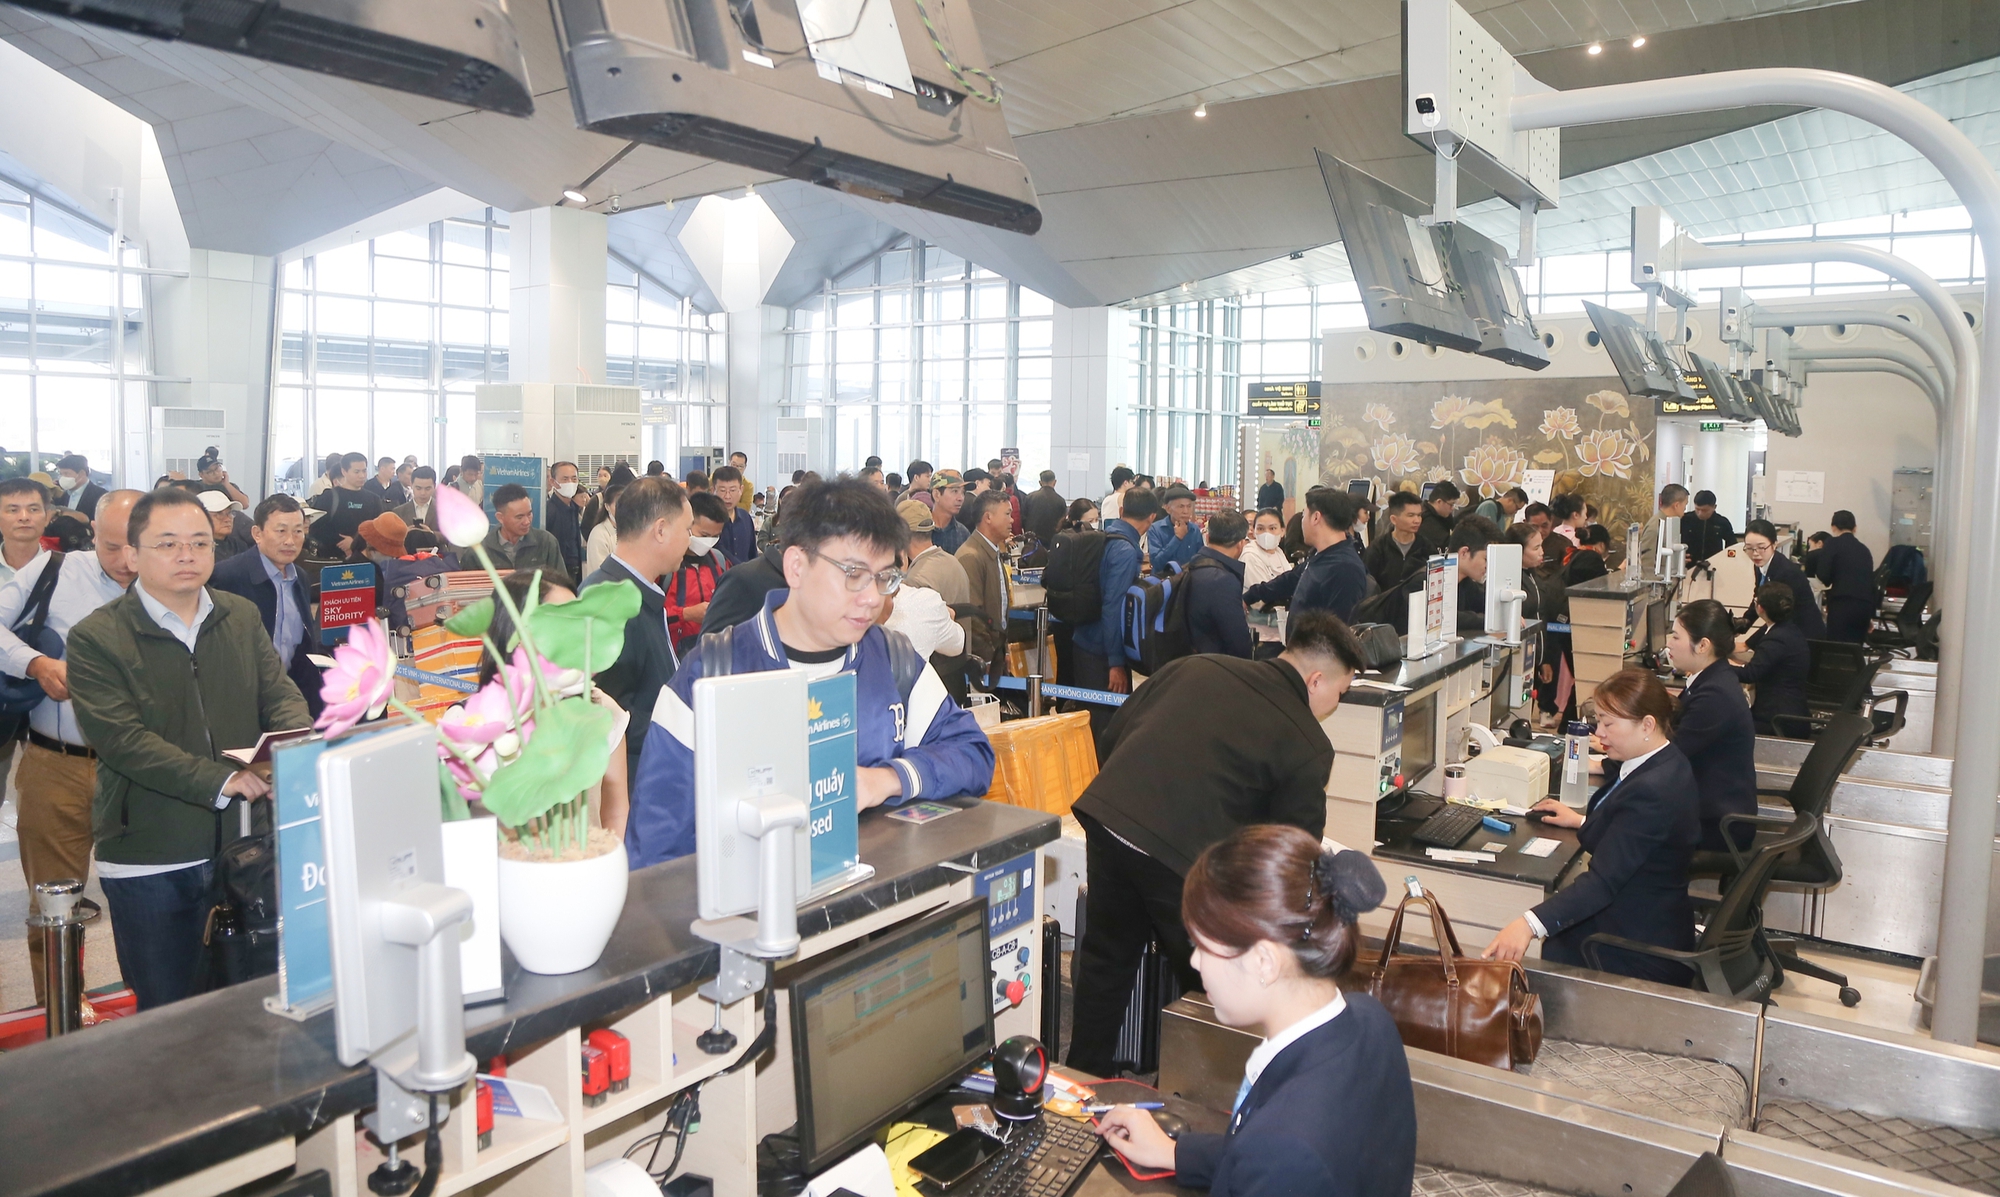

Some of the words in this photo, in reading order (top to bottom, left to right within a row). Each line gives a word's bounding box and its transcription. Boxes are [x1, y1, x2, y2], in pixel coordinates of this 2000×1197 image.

[323, 598, 342, 606] KHÁCH
[324, 606, 342, 615] SKY
[324, 611, 364, 622] PRIORITY
[407, 669, 418, 678] VINH
[419, 672, 430, 681] VINH
[429, 675, 462, 689] INTERNATIONAL
[461, 682, 479, 692] AIRPOR
[1058, 688, 1082, 698] KHÔNG
[1082, 691, 1102, 701] QUỐC
[1103, 693, 1112, 703] TẾ
[1113, 696, 1127, 704] VIN
[810, 808, 833, 838] sed
